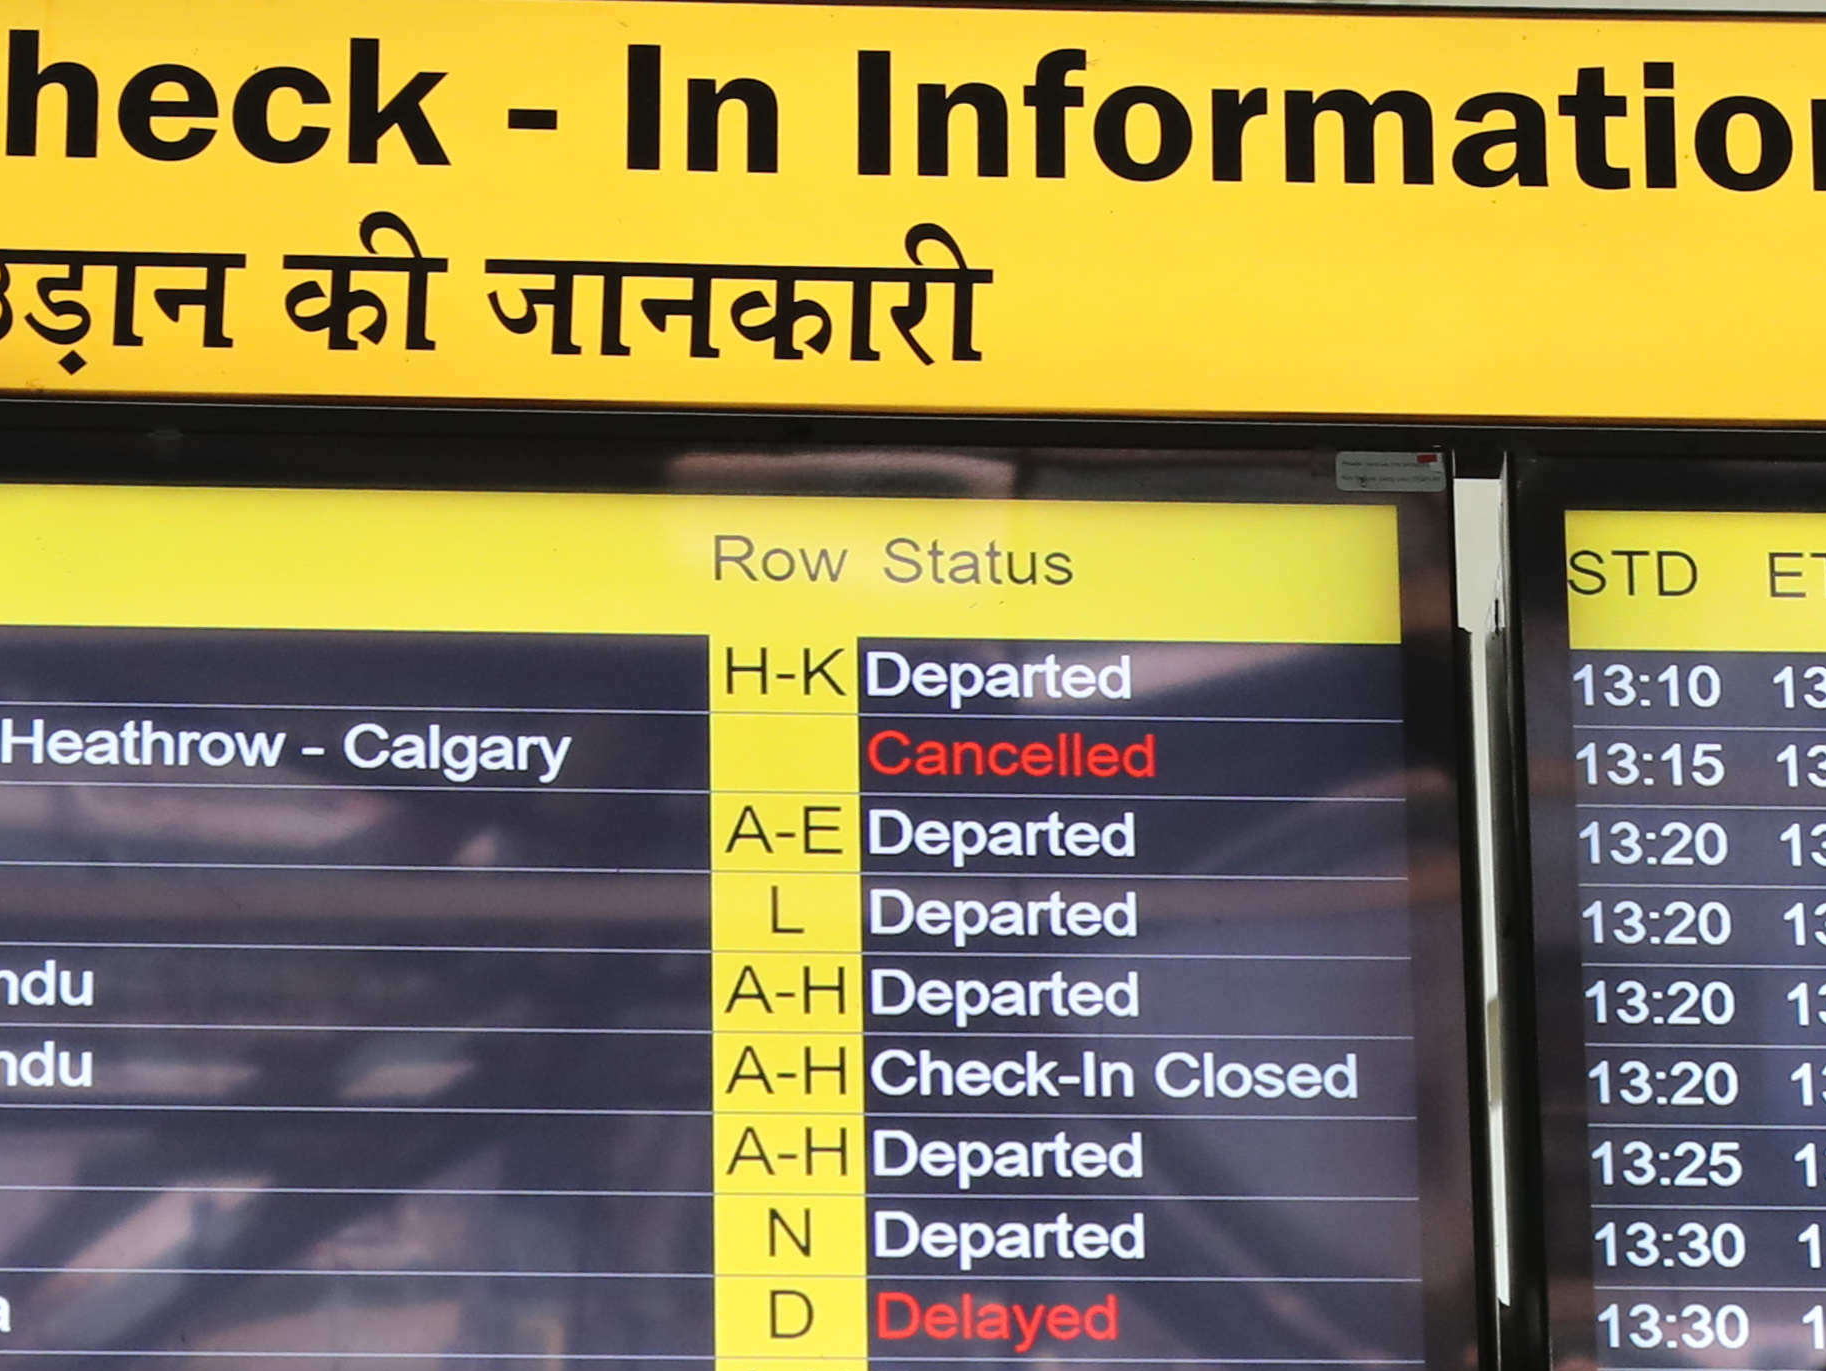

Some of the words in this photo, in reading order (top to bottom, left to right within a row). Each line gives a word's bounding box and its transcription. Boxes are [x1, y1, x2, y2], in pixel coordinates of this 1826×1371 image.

[508, 109, 557, 130] -
[627, 44, 778, 173] In
[283, 211, 448, 350] की
[485, 223, 993, 365] जानकारी
[715, 535, 847, 582] Row
[885, 538, 1073, 585] Status
[1567, 550, 1698, 600] STD
[1574, 664, 1720, 707] 13:10
[1, 719, 286, 766] Heathrow
[344, 723, 572, 783] Calgary
[867, 730, 1155, 777] Cancelled
[772, 886, 804, 934] L
[870, 889, 1136, 947] Departed
[1589, 1061, 1738, 1105] 13:20
[769, 1208, 810, 1257] N
[875, 1211, 1144, 1270] Departed
[876, 1292, 1119, 1353] Delayed
